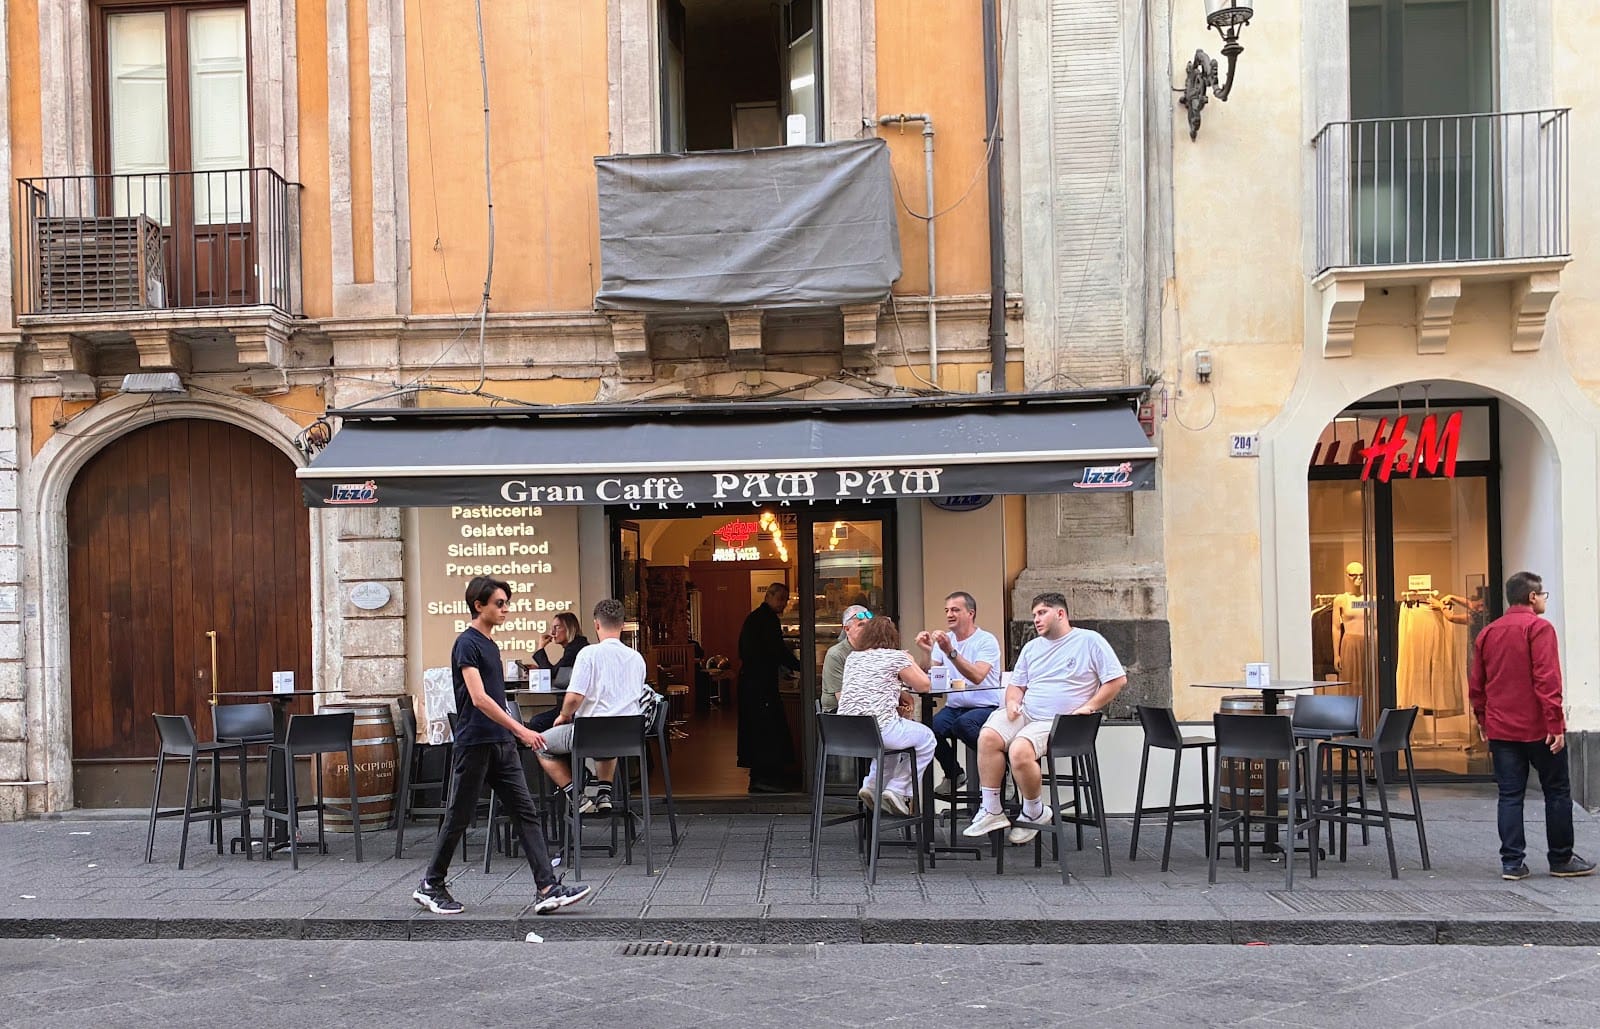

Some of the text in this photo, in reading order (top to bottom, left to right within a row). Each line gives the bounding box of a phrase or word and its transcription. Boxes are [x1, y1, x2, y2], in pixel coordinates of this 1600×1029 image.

[1234, 436, 1251, 449] 204
[1359, 410, 1462, 483] H&M
[500, 468, 943, 502] Gran Caffè PAM PAM
[452, 505, 542, 519] Pasticceria
[461, 523, 534, 538] Gelateria
[448, 541, 549, 557] Sicilian Food
[446, 560, 552, 576] Proseccheria
[427, 598, 572, 615] Sicilia aft Beer
[454, 617, 547, 634] Baueting
[498, 637, 536, 653] ering
[337, 761, 380, 774] PRNCIPI
